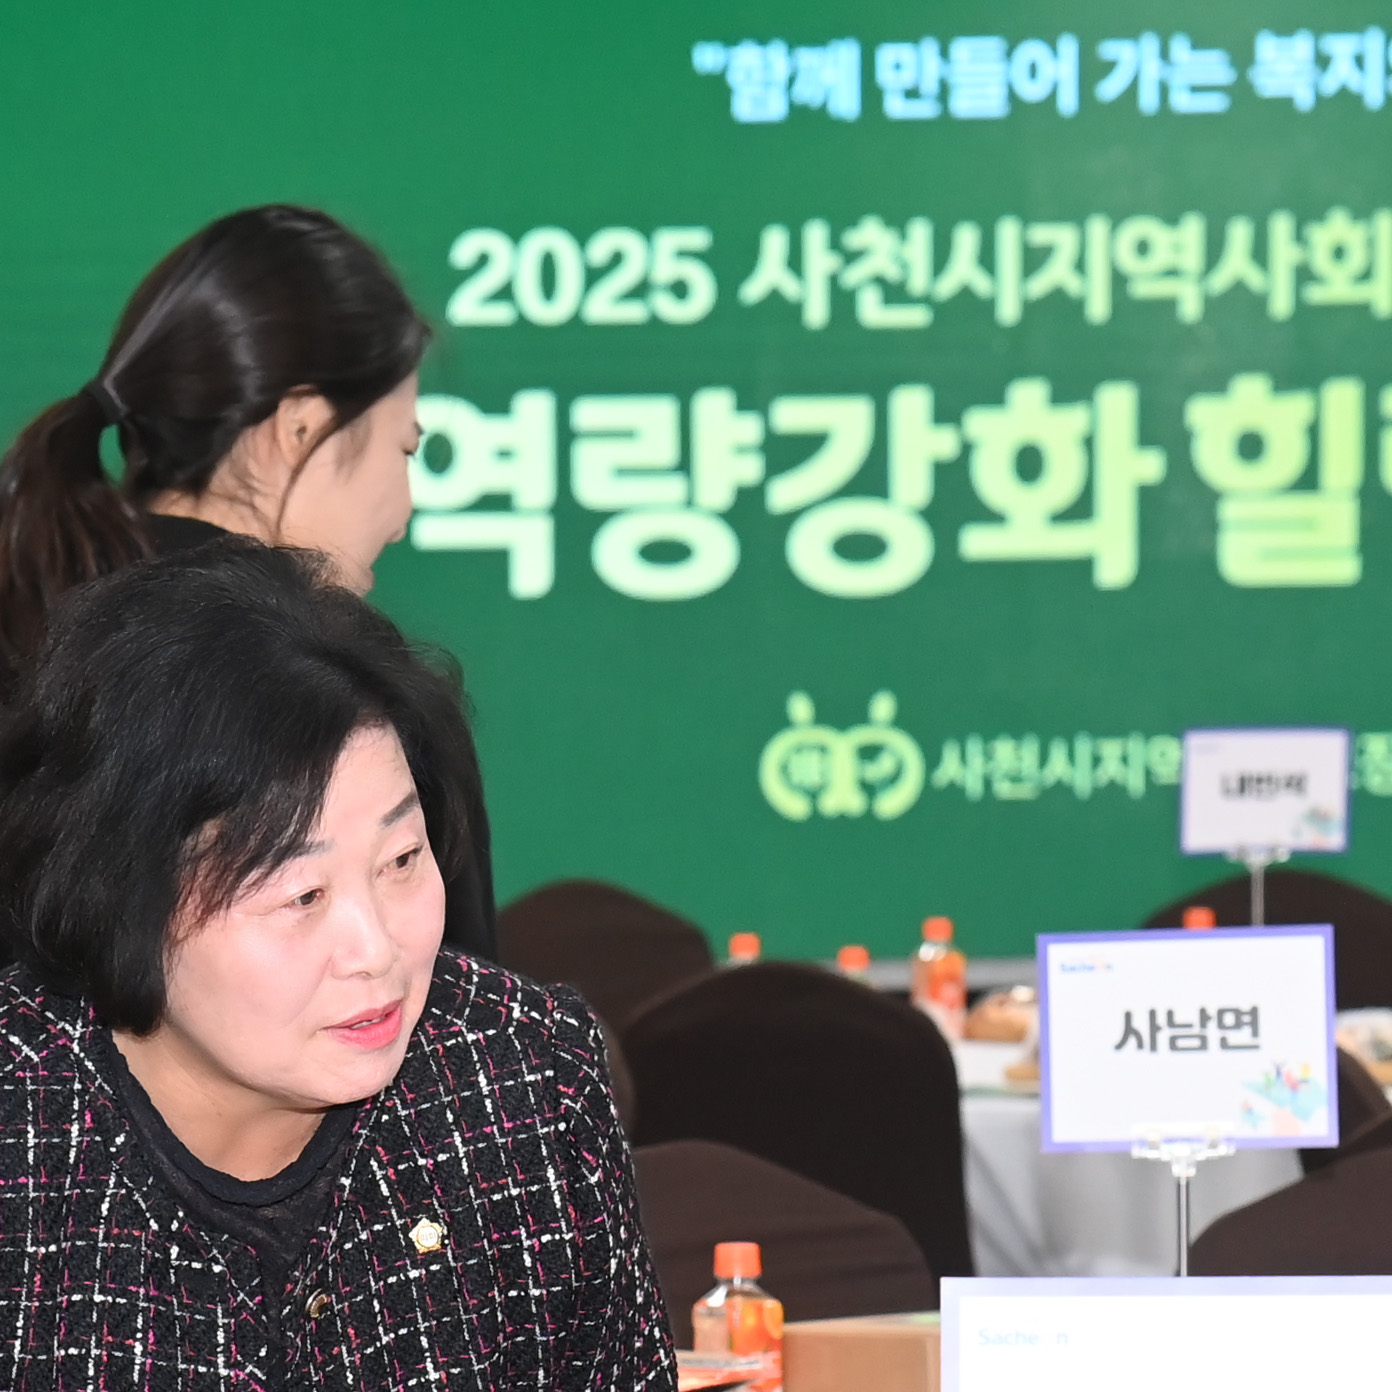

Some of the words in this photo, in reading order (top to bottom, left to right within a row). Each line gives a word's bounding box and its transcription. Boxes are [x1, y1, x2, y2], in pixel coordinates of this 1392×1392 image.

[875, 34, 1079, 120] 만들어
[1094, 30, 1237, 116] 가는
[446, 227, 716, 327] 2025
[411, 377, 1166, 602] 역량강화
[1114, 1004, 1261, 1053] 사남면
